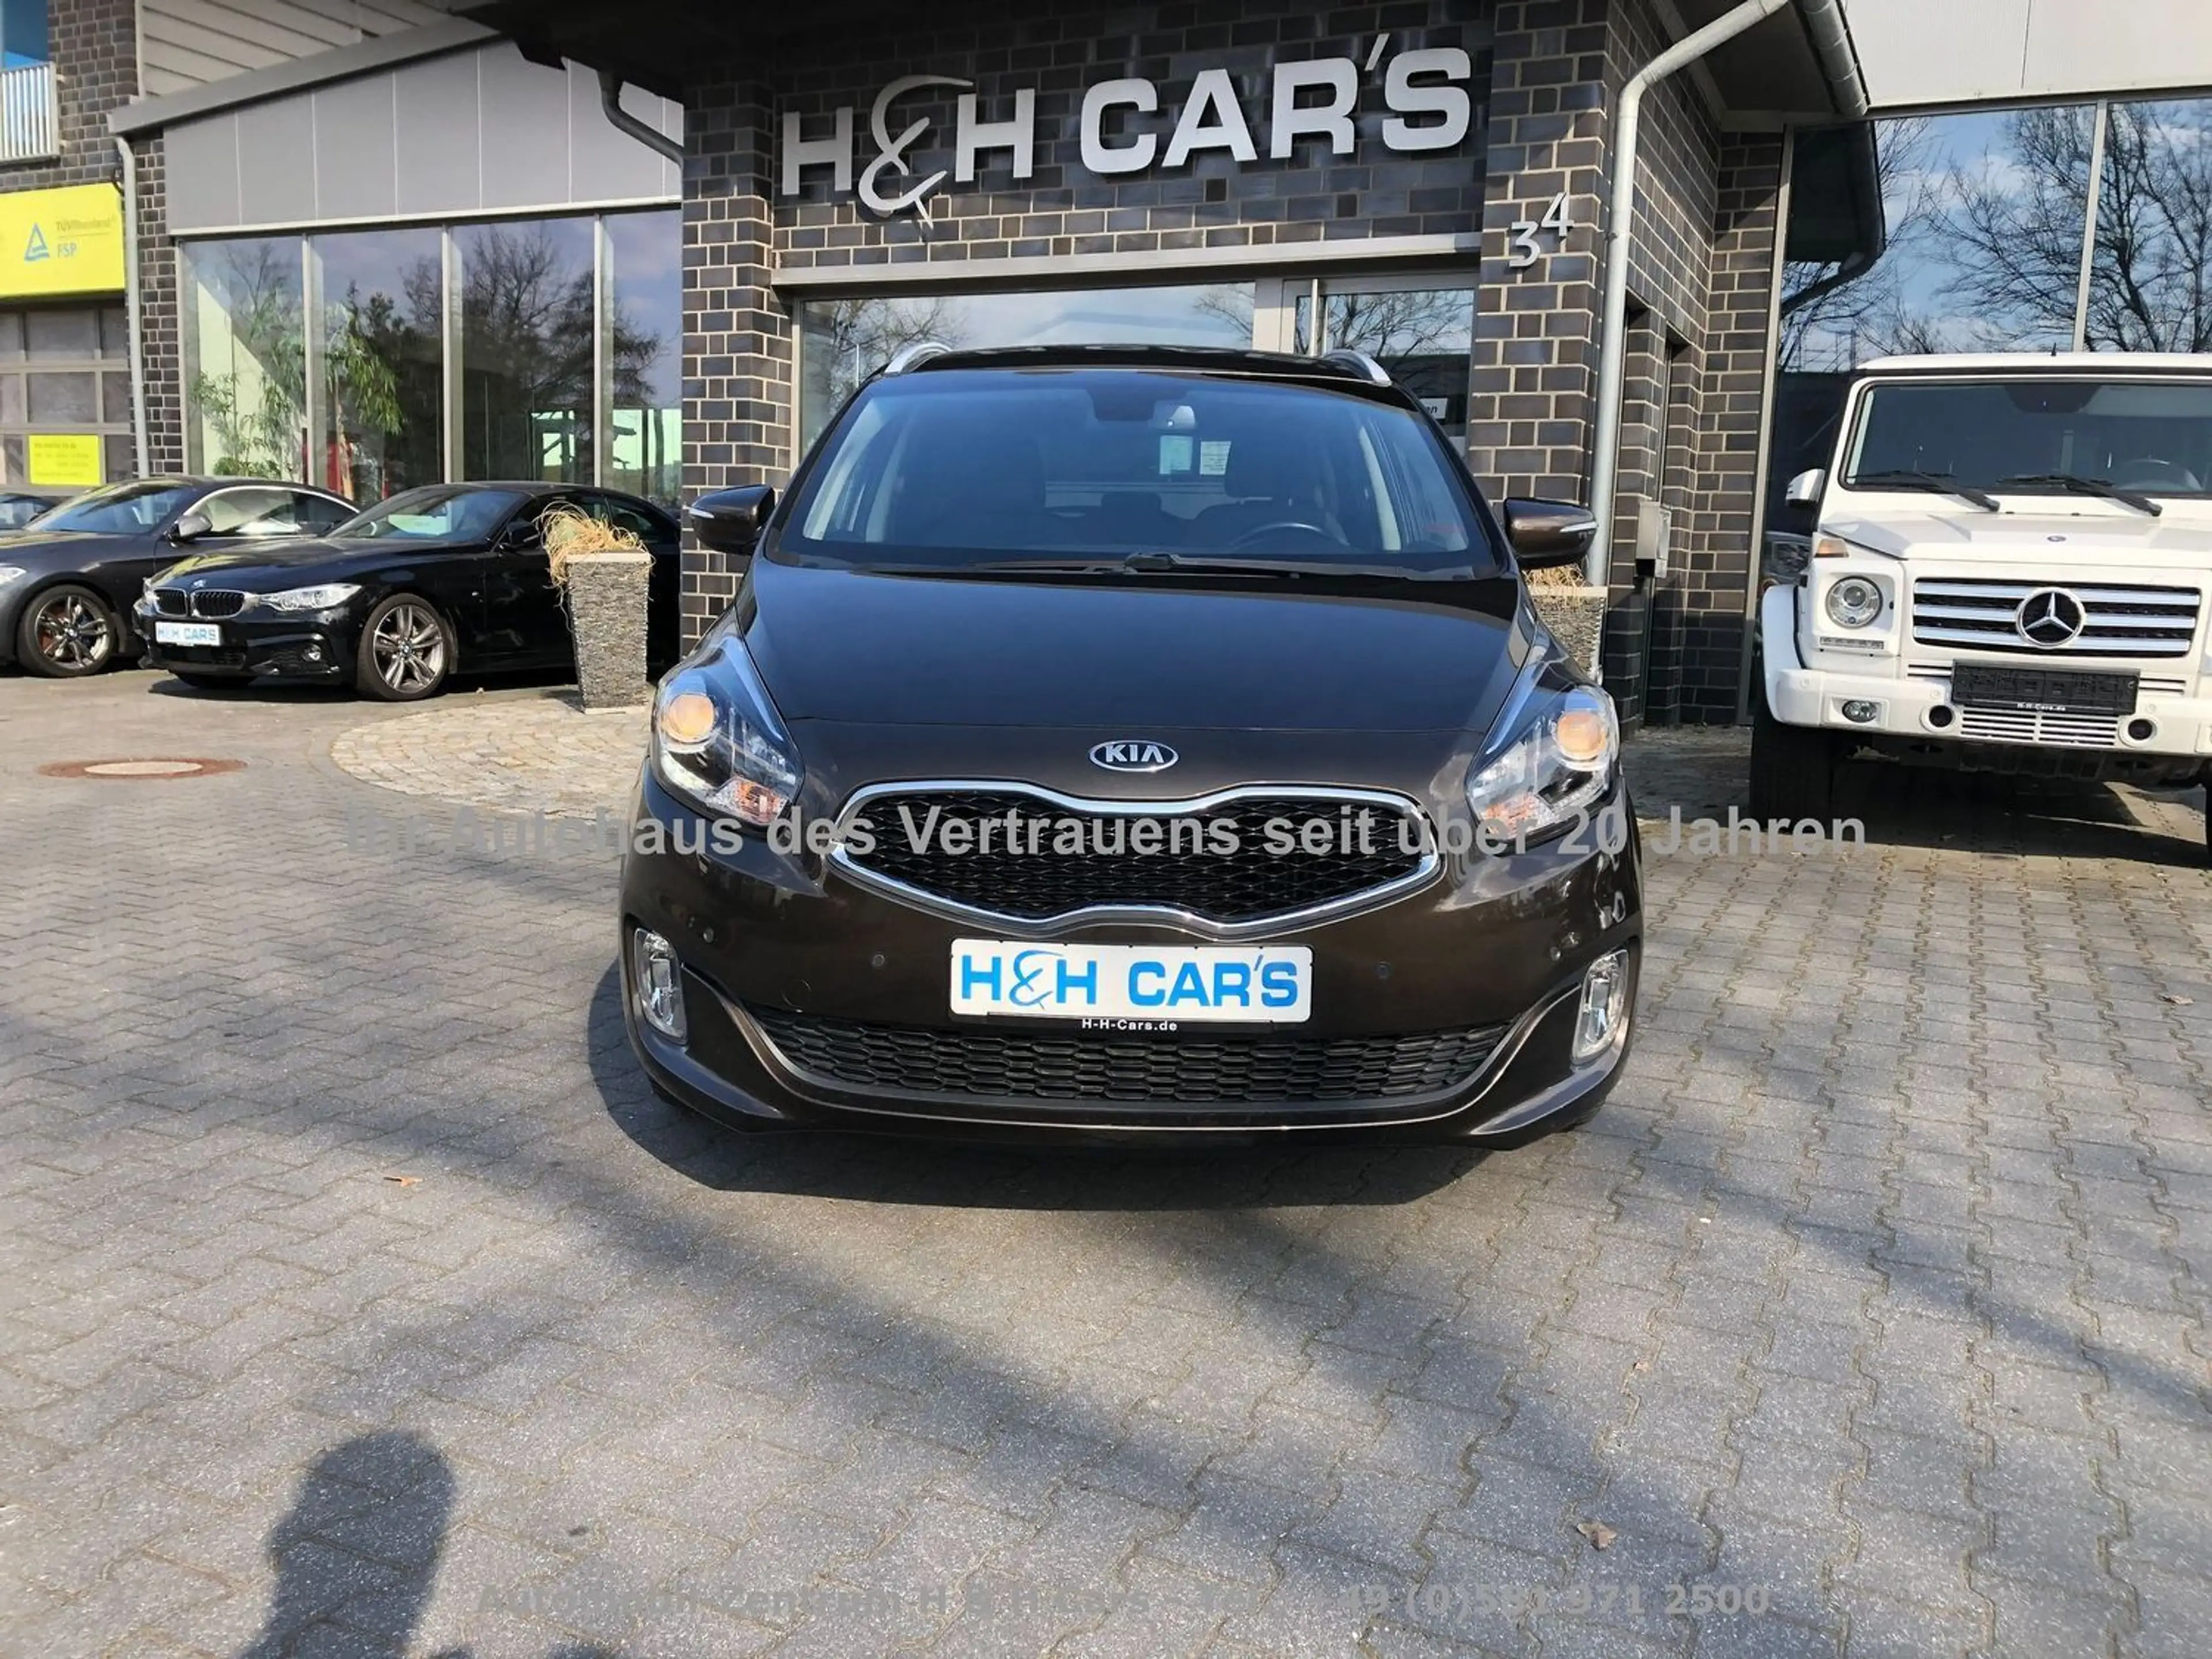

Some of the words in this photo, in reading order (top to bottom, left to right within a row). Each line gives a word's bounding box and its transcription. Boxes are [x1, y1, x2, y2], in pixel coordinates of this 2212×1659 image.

[782, 74, 1035, 228] H&H
[57, 243, 77, 257] FSP
[1105, 744, 1164, 763] KIA
[961, 949, 1097, 1009] H&H
[1128, 955, 1298, 1007] CAR'S
[1082, 1018, 1177, 1032] H-H-Cars.de
